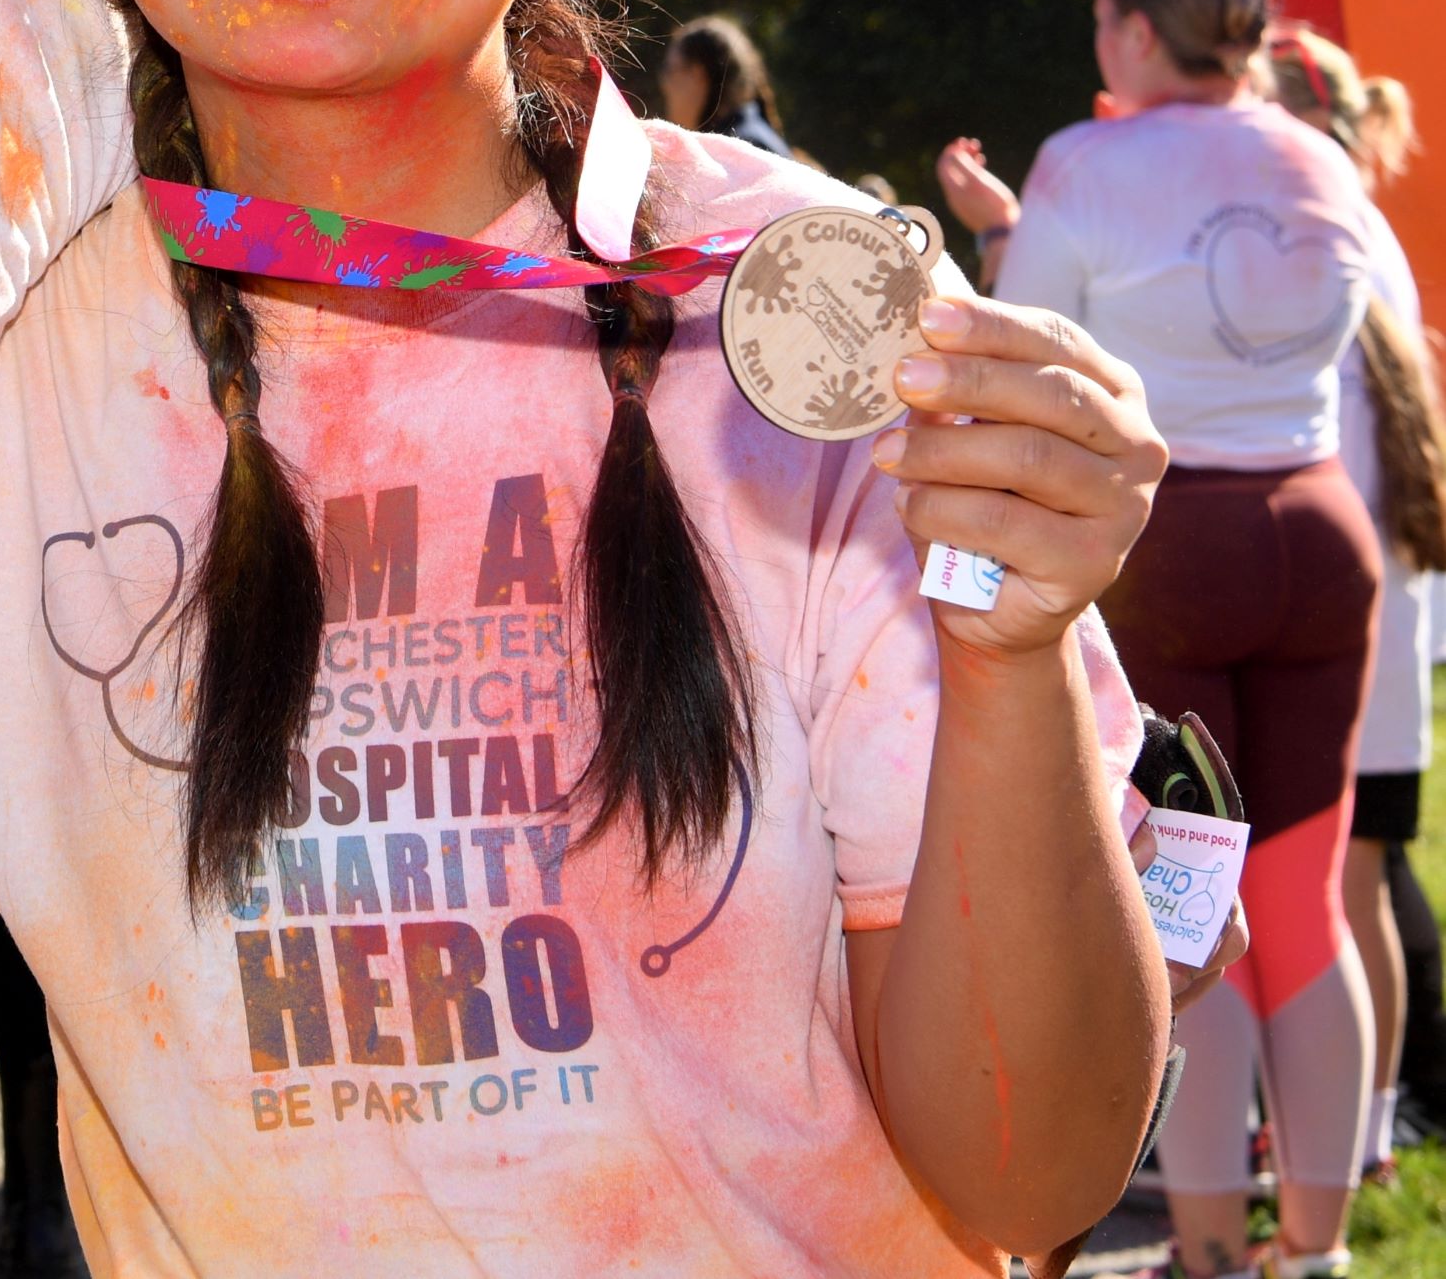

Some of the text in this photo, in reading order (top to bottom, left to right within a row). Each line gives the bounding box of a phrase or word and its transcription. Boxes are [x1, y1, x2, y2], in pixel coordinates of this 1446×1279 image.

[803, 219, 890, 257] Colour
[814, 310, 859, 360] Charity
[739, 338, 775, 395] Run
[475, 473, 563, 608] A
[323, 613, 569, 675] CHESTER
[304, 669, 568, 738] PSWICH
[273, 733, 571, 829] OSPITAL
[1157, 824, 1186, 841] drink
[1189, 830, 1210, 843] and
[1211, 834, 1238, 851] Food
[234, 913, 594, 1073] HERO
[250, 1064, 600, 1132] BE PART OF IT
